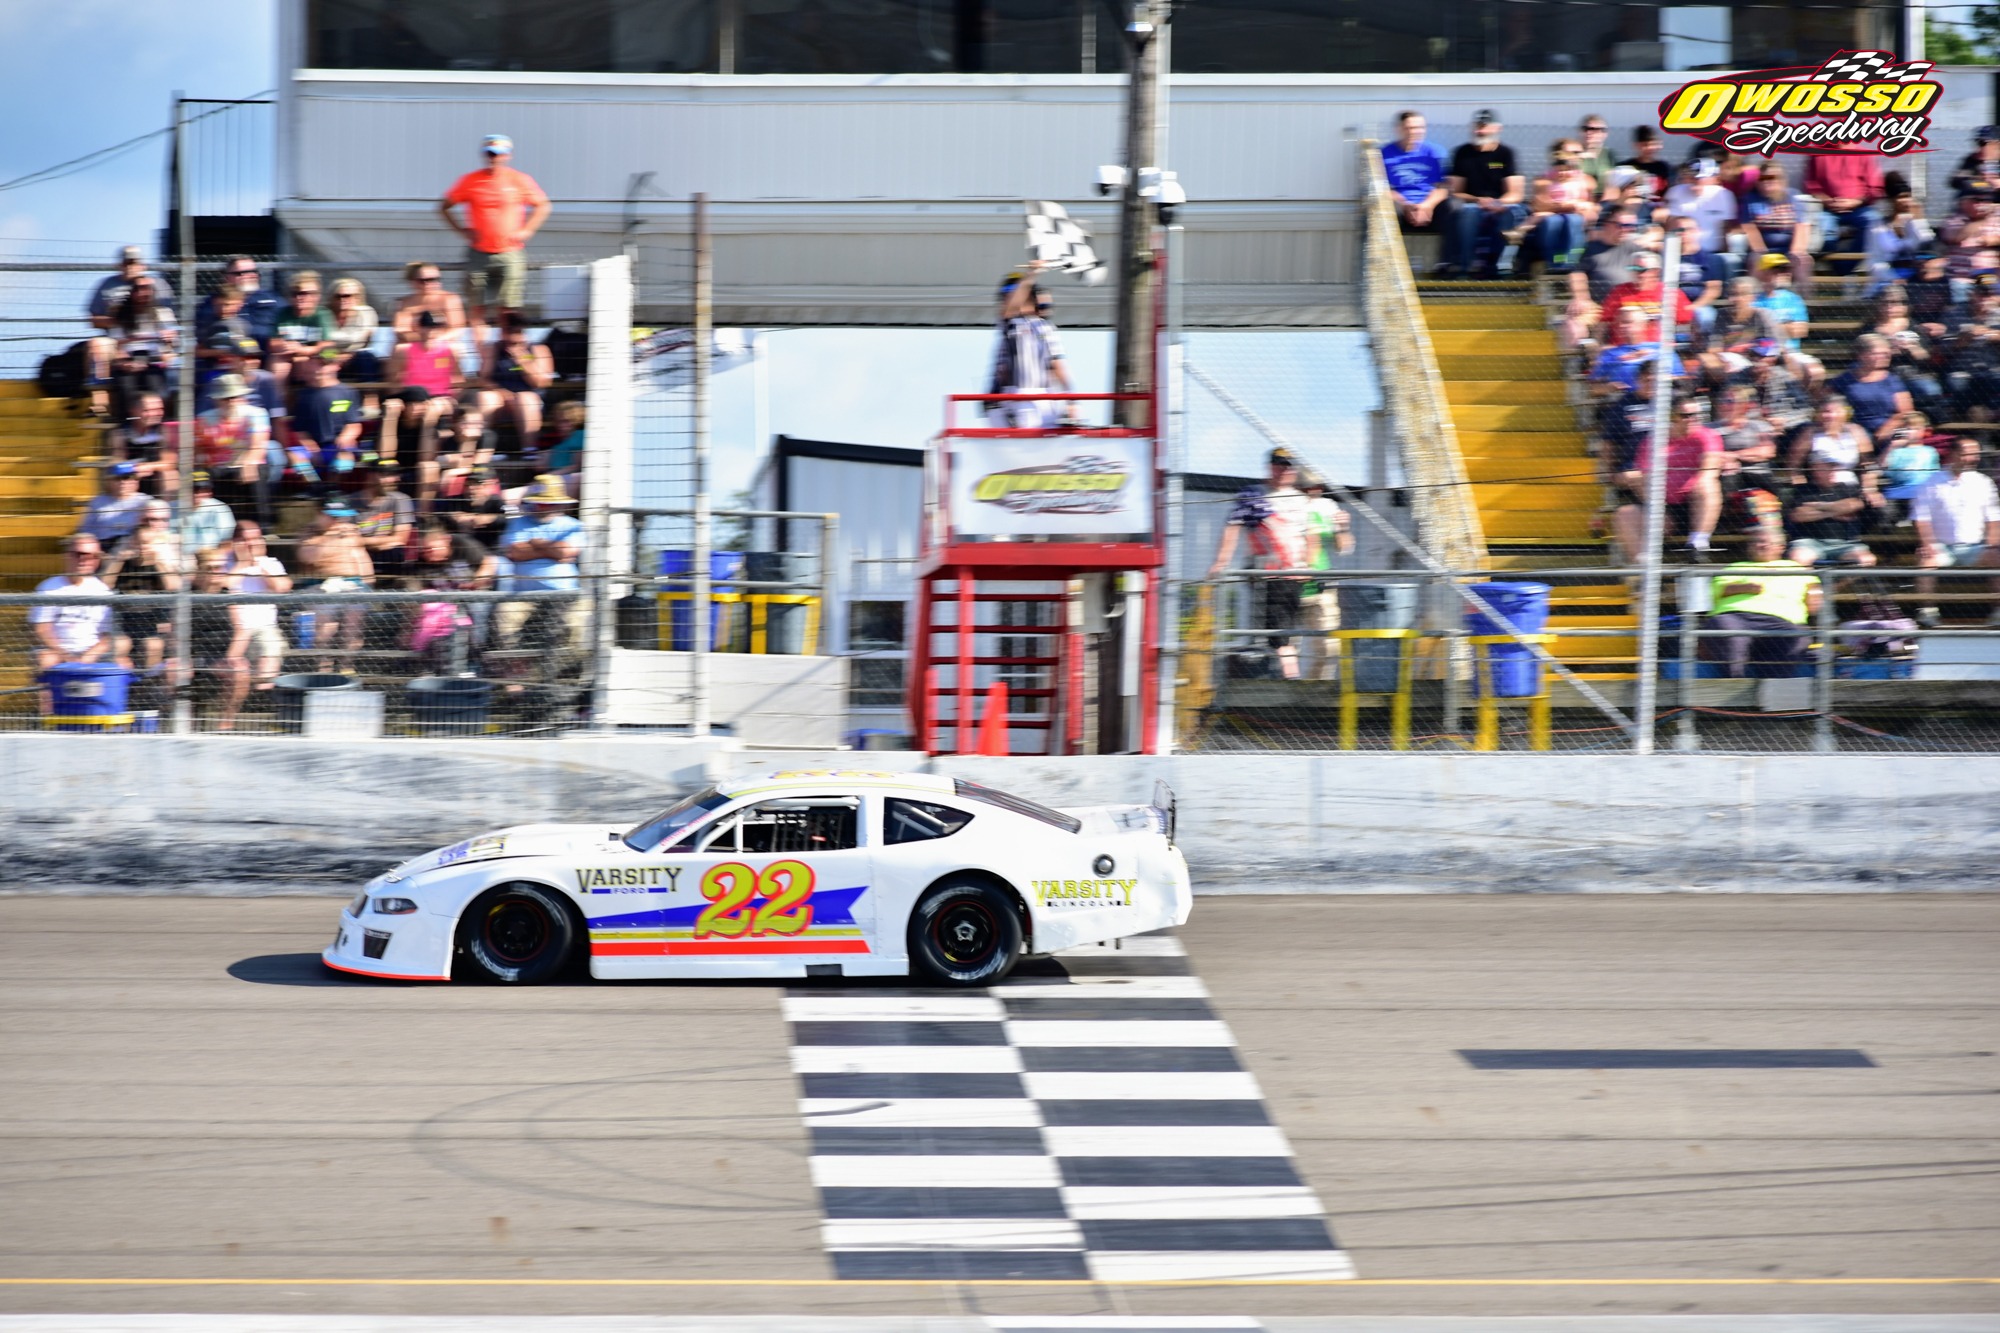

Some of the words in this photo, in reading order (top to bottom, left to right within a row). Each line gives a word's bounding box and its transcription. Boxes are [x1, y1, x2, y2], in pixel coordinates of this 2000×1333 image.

[576, 867, 682, 893] VARSITY
[1031, 880, 1137, 906] VARSITY
[694, 859, 816, 940] 22
